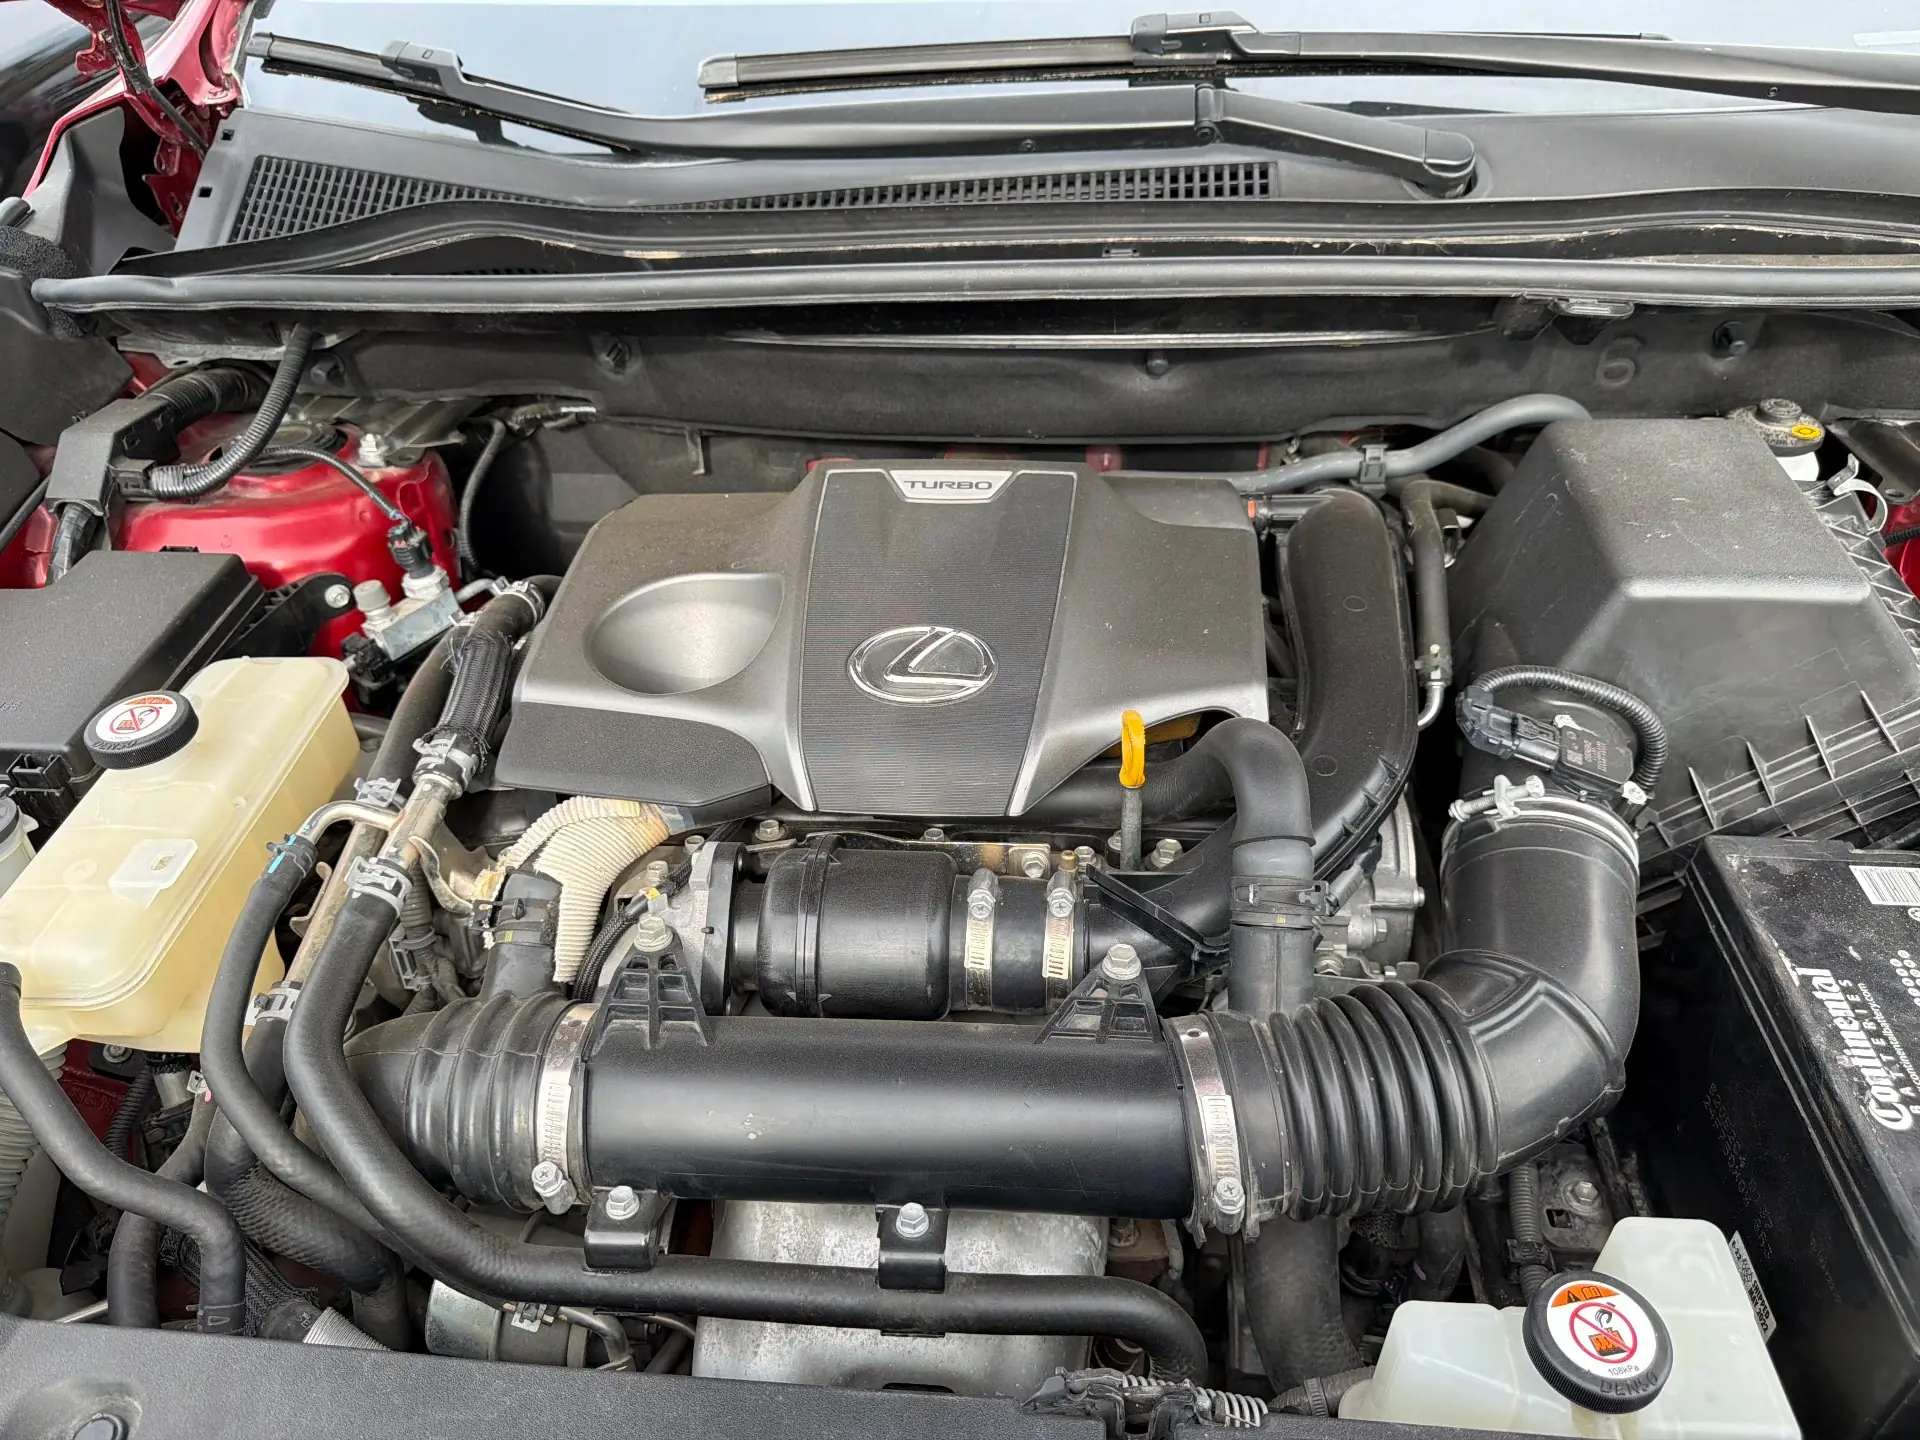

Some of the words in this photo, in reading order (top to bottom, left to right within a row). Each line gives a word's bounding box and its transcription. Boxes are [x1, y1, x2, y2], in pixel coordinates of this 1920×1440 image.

[903, 480, 992, 490] TURBO
[91, 740, 137, 750] DENSO
[1779, 951, 1913, 1130] Continental
[1838, 979, 1920, 1114] BATTERIES
[1747, 1288, 1758, 1307] MAY
[1756, 1307, 1768, 1334] 2022
[1751, 1280, 1769, 1319] SHIPPED
[1600, 1371, 1658, 1396] DENSO
[1608, 1365, 1640, 1376] 108kPa
